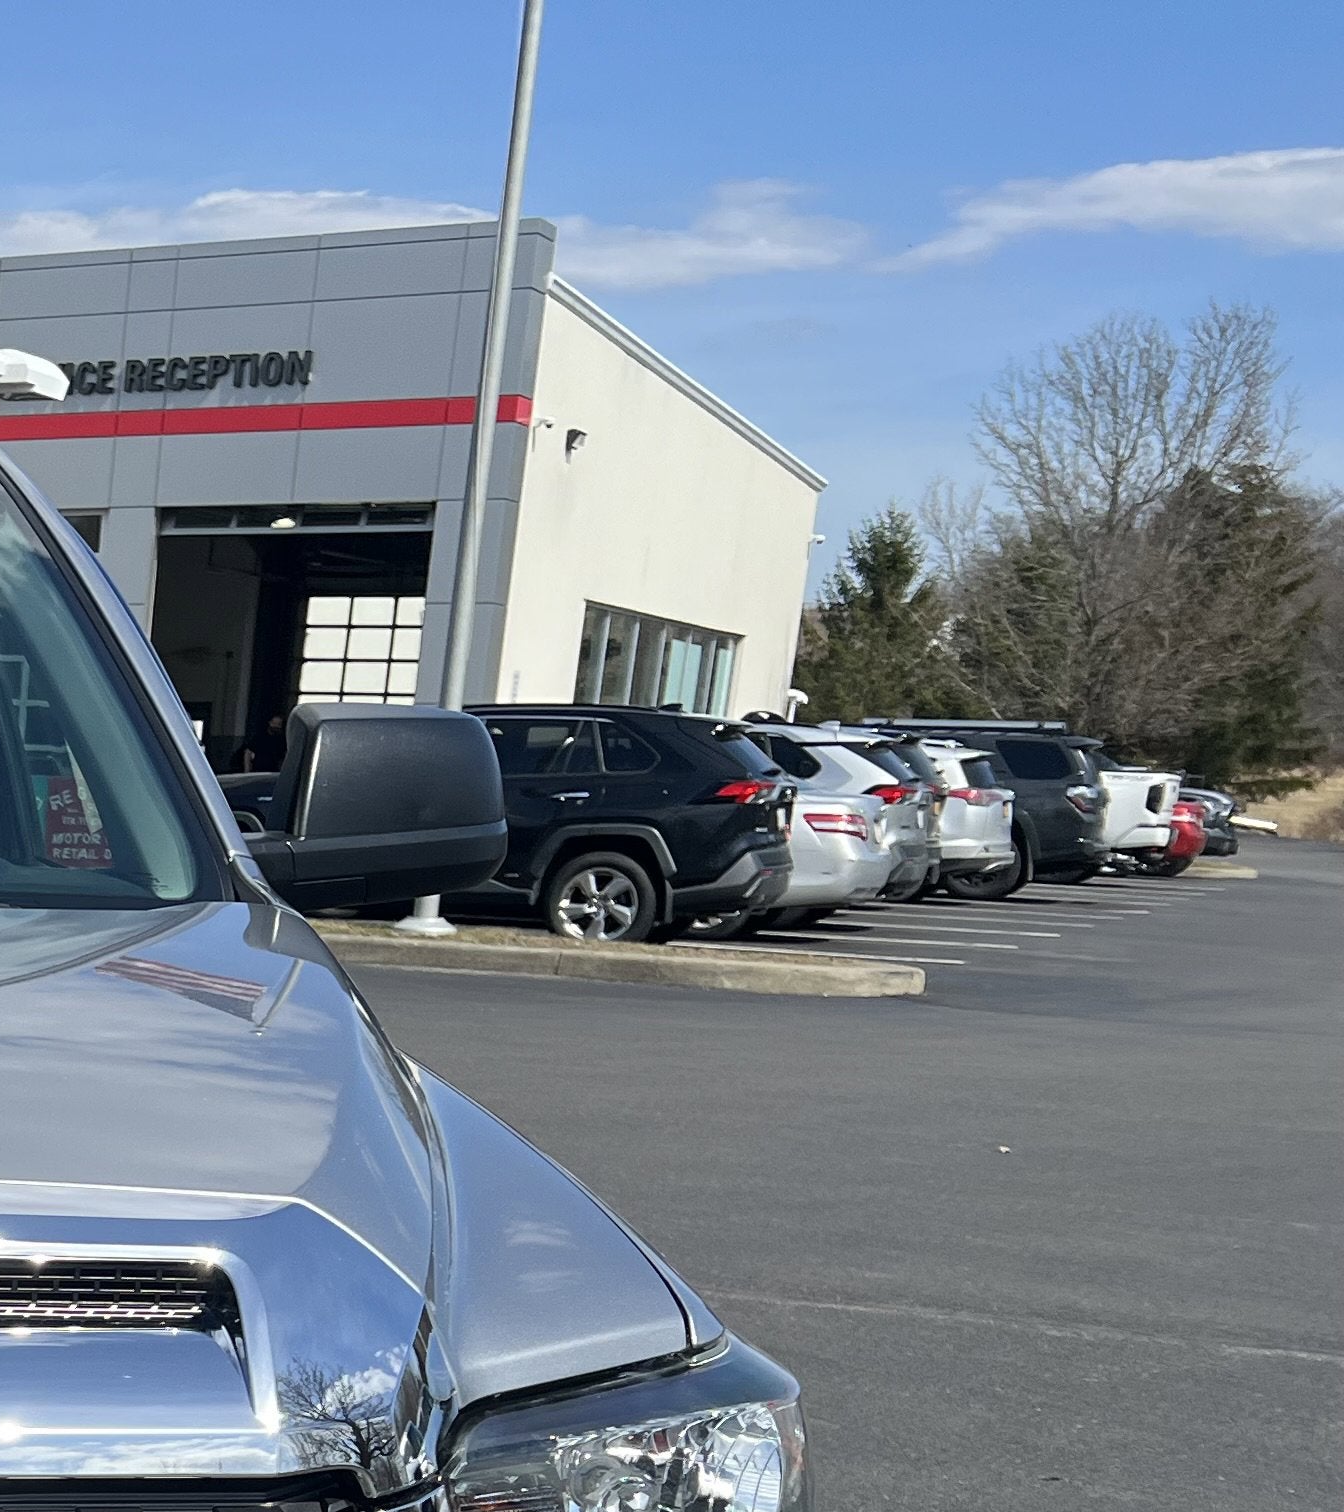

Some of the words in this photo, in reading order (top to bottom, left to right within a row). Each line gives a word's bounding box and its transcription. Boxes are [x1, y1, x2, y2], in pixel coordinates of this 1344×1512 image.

[58, 360, 116, 396] ICE
[123, 350, 314, 394] RECEPTION
[51, 832, 102, 845] MOTOR
[52, 847, 99, 860] RETAIL
